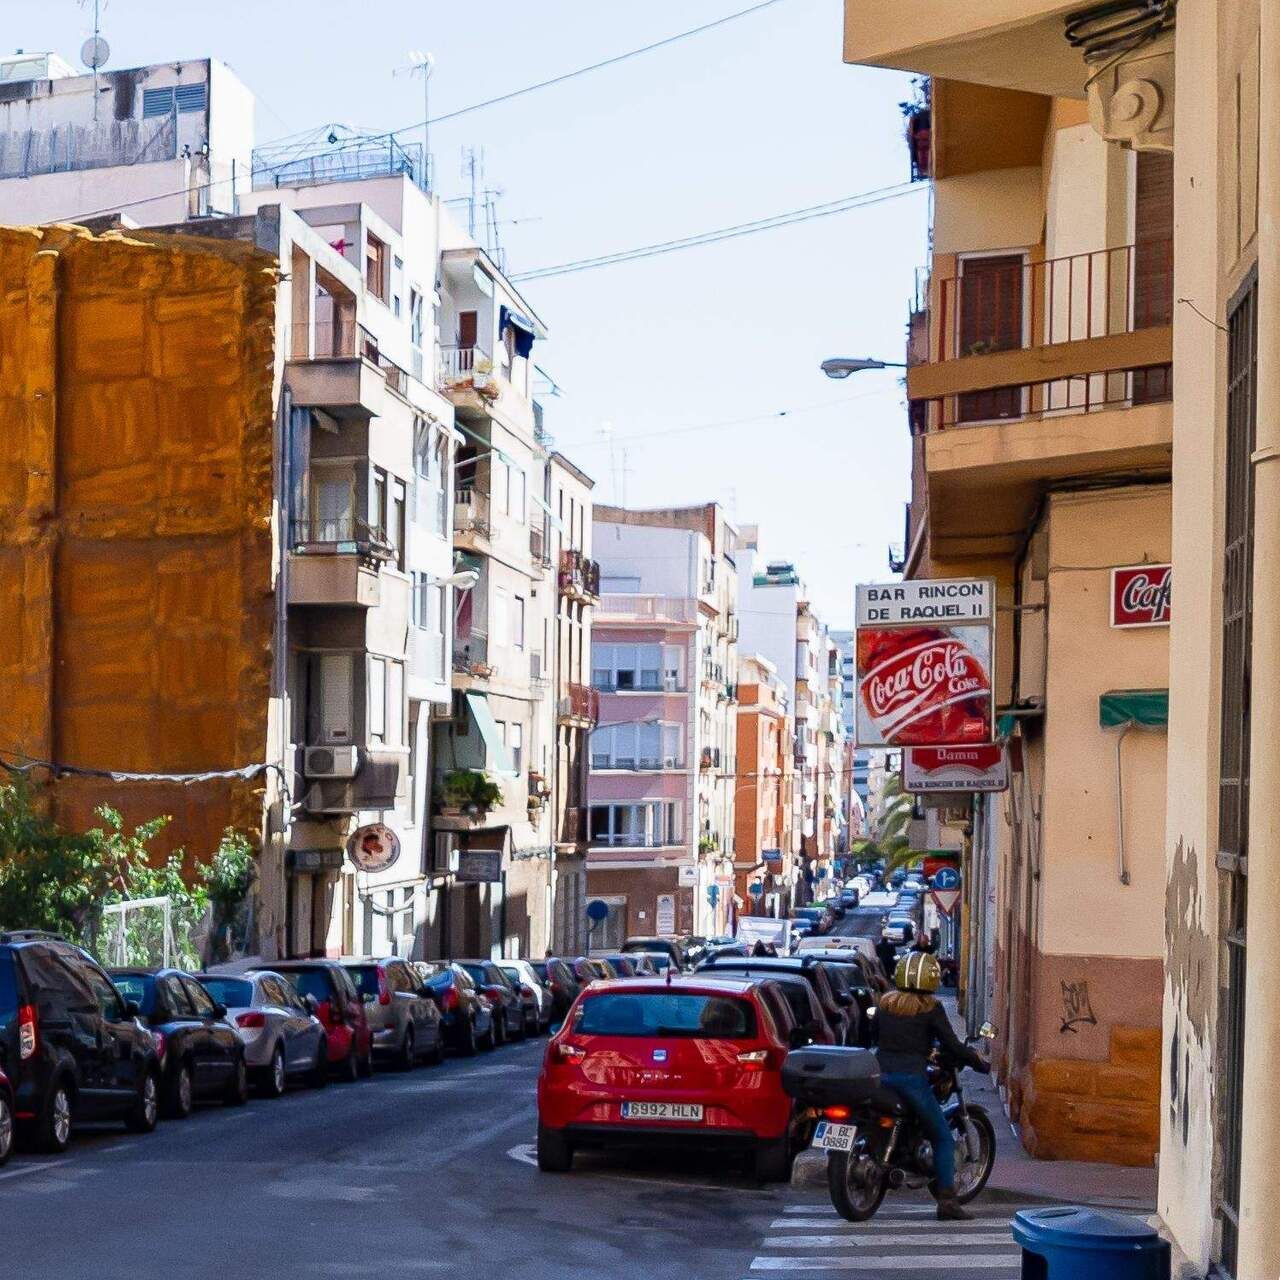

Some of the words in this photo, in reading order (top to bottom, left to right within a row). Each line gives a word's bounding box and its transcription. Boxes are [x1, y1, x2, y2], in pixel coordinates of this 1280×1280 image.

[867, 588, 905, 601] BAR
[918, 584, 983, 599] RINCON
[1121, 569, 1171, 621] Caf
[867, 608, 889, 620] DE
[900, 604, 965, 619] RAQUEL
[869, 645, 967, 714] Coca-Cola
[937, 748, 979, 761] Damm
[631, 1102, 667, 1116] 6992
[671, 1104, 699, 1117] HLN
